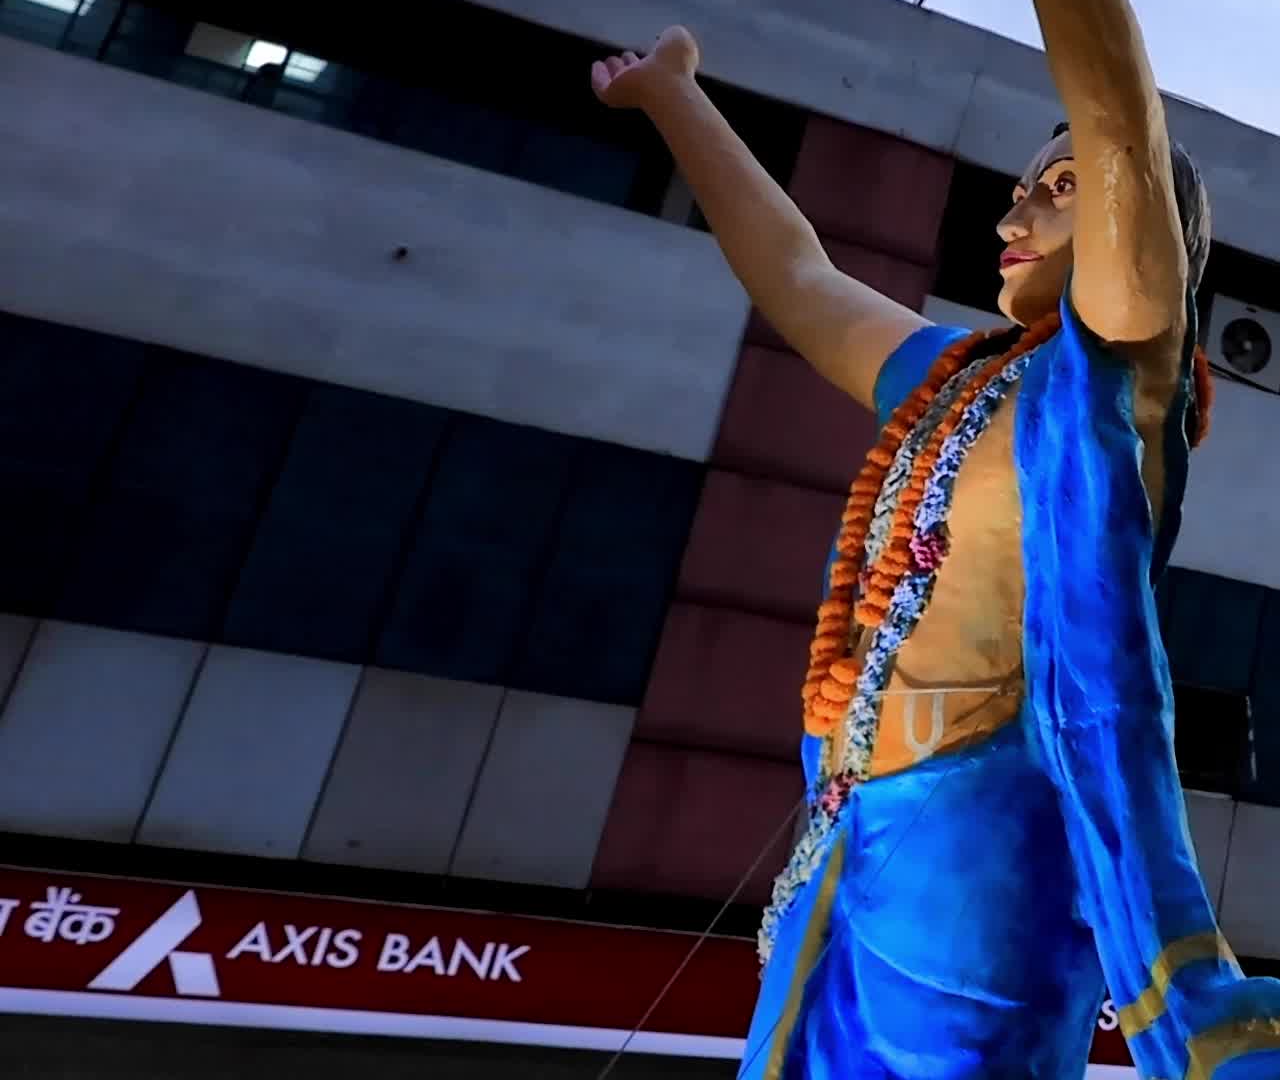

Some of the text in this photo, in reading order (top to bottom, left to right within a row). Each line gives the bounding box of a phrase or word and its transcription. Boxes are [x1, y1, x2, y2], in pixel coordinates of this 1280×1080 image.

[24, 886, 120, 945] बैंक
[225, 921, 531, 982] AXIS BANK
